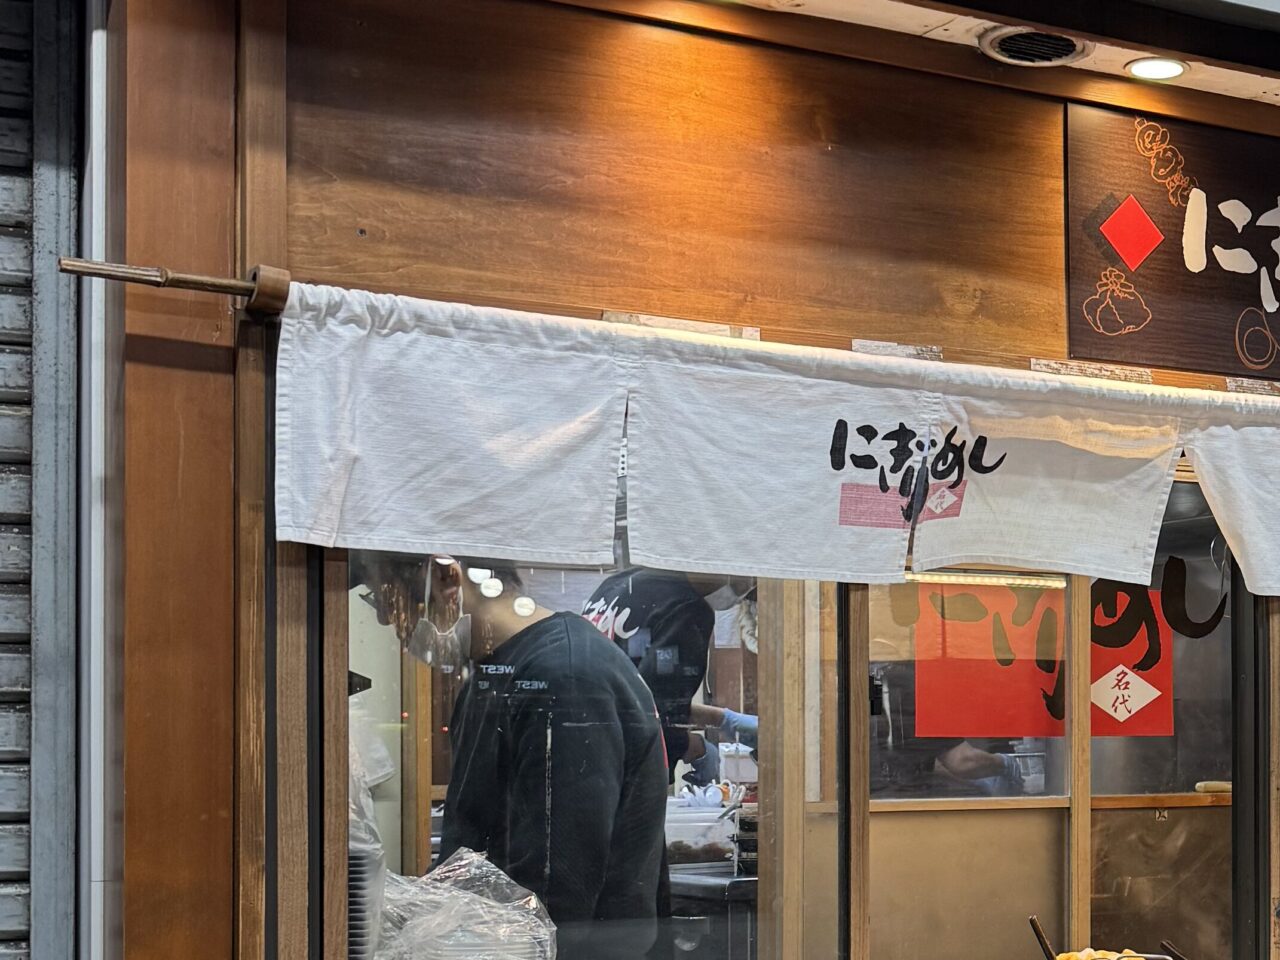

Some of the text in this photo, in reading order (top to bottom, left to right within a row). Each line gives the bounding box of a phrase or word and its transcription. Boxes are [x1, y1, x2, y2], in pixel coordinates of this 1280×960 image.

[830, 419, 1007, 522] にぎりめし
[1111, 669, 1133, 715] 名代
